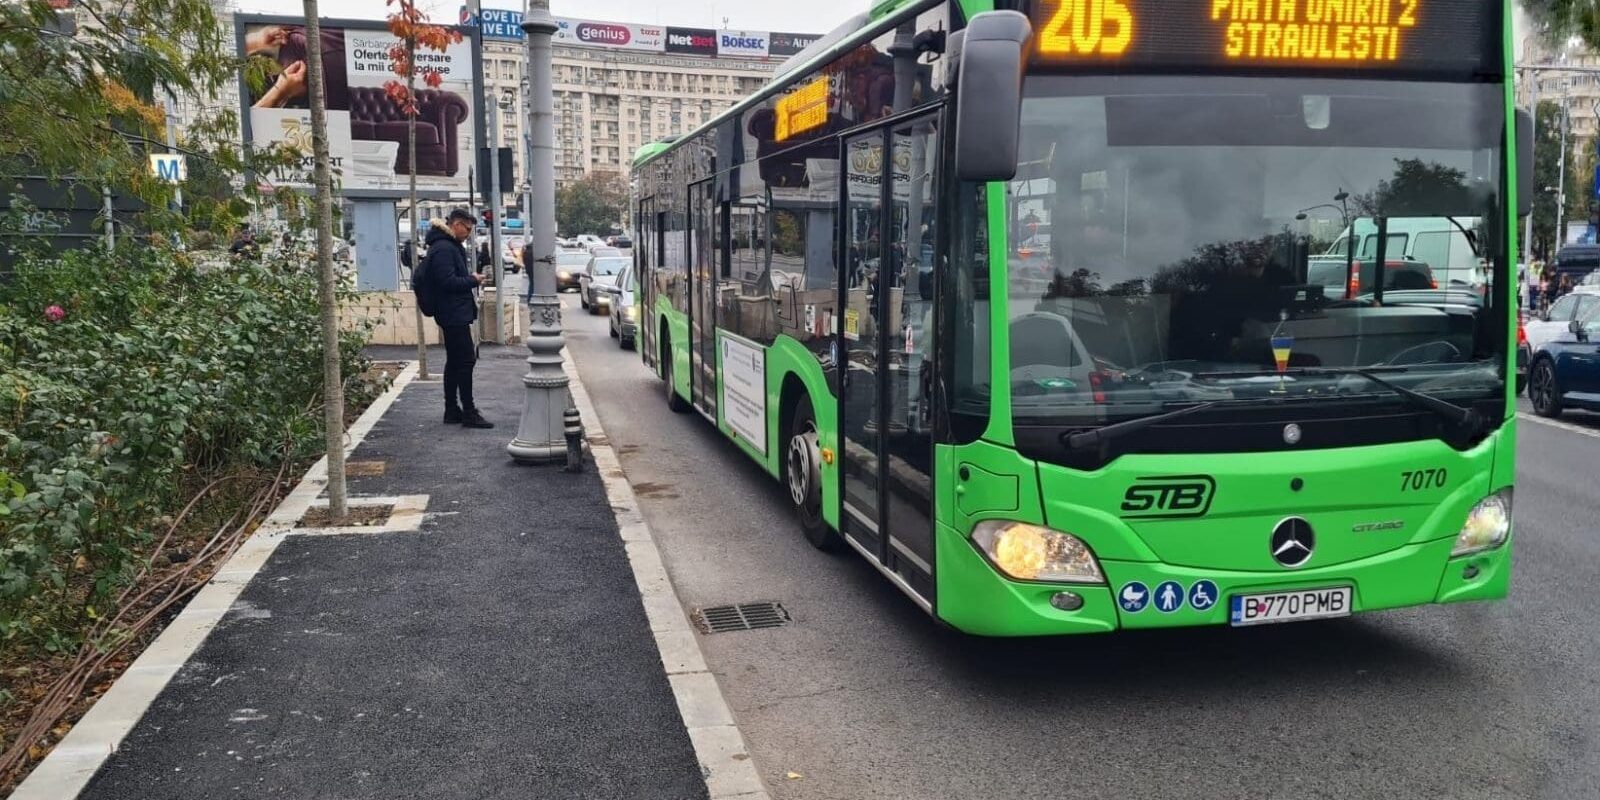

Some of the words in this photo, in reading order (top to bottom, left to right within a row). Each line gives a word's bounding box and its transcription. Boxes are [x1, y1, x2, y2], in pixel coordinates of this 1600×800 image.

[482, 10, 509, 22] OVE
[1398, 0, 1418, 25] 2
[483, 23, 503, 34] IVE
[581, 26, 625, 40] genius
[1040, 0, 1133, 53] 205
[669, 33, 714, 47] NetBet
[721, 35, 765, 49] BORSEC
[1226, 22, 1399, 60] STRAULESTI
[353, 48, 388, 60] Oferte
[354, 61, 365, 71] la
[368, 62, 385, 72] mii
[157, 159, 179, 180] M
[1401, 468, 1447, 491] 7070
[1120, 483, 1208, 511] STB
[1245, 598, 1260, 618] B
[1264, 595, 1300, 617] 770
[1303, 591, 1344, 613] PMB
